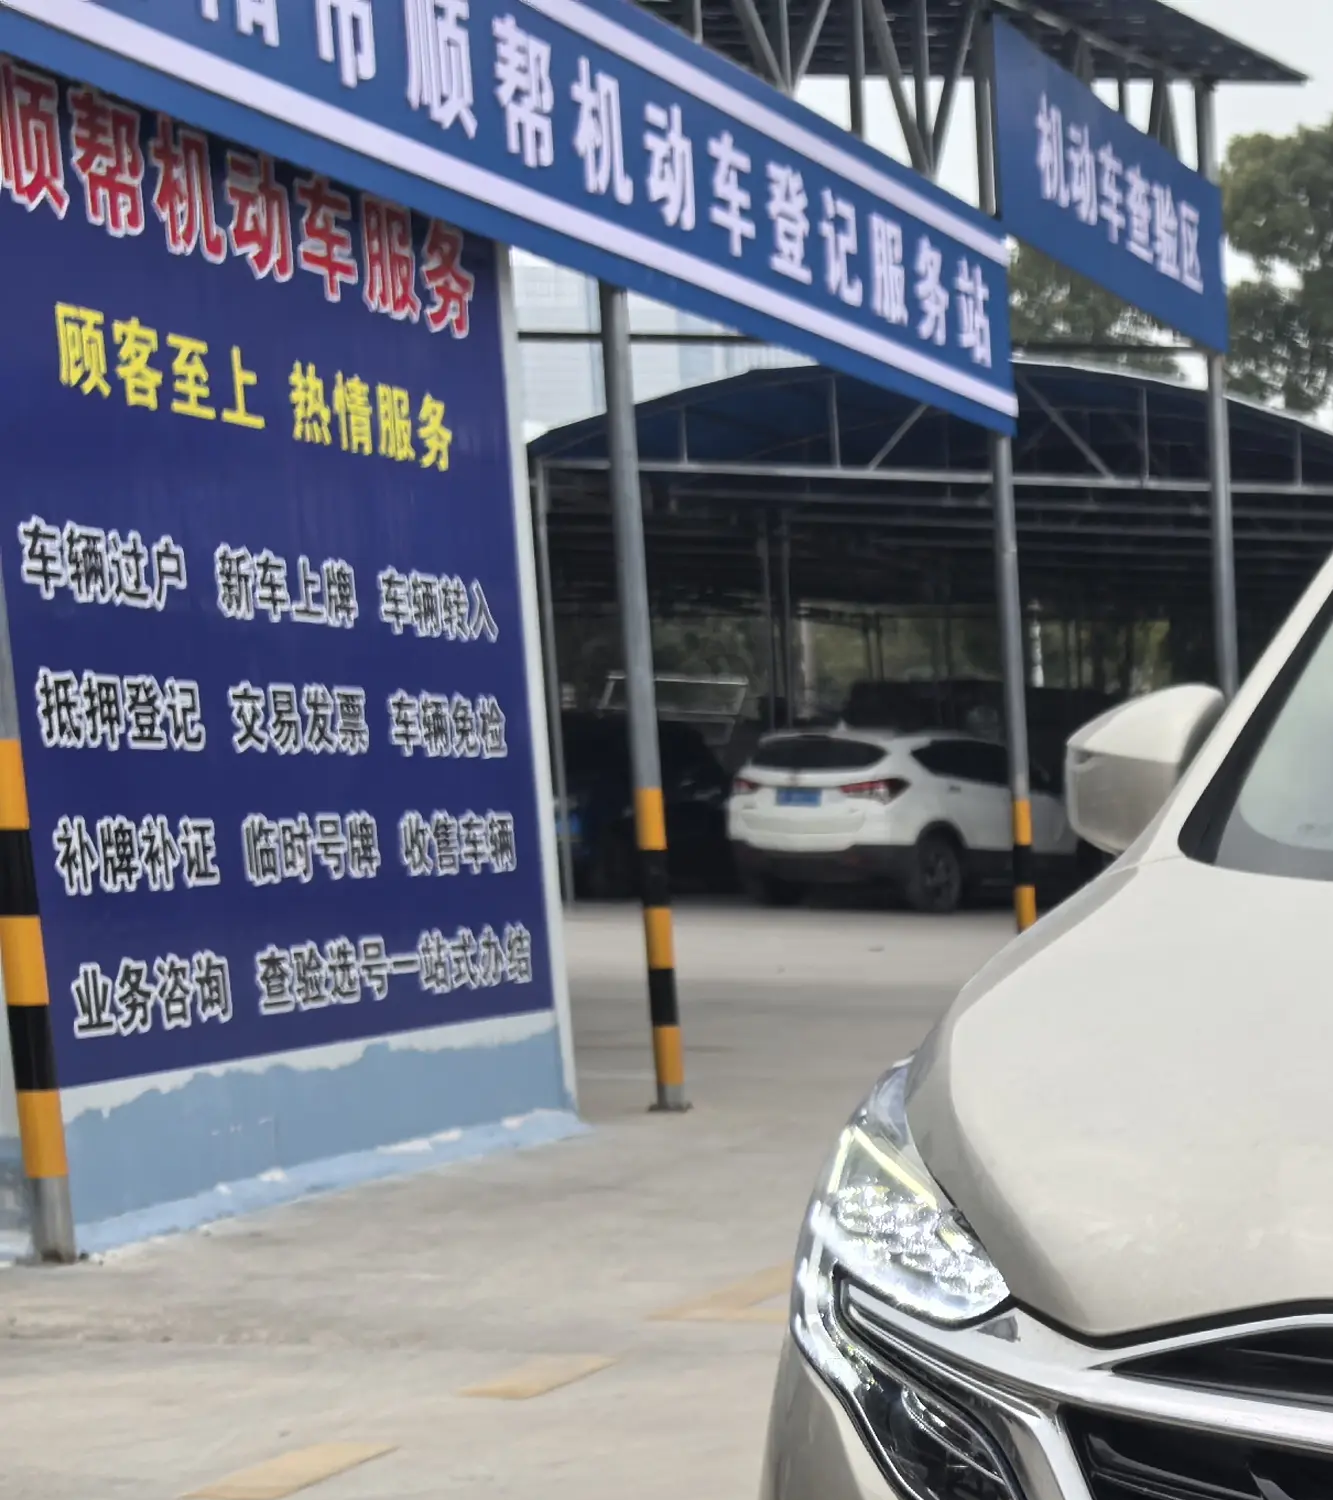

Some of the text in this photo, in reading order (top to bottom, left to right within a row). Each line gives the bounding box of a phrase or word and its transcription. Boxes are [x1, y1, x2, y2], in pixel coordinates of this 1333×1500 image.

[0, 61, 474, 338] 顺帮机动车服务
[1034, 93, 1205, 295] 机动车查验区
[55, 302, 453, 472] 顾客至上 热情服务
[18, 516, 499, 643] 车辆过户 新车上牌 车辆转入
[35, 667, 508, 759] 抵押登记 交易发票 车辆免检
[53, 809, 518, 896] 补牌补证 临时号牌 收售车辆
[71, 922, 532, 1039] 业务咨询 查验选号一站式办结
